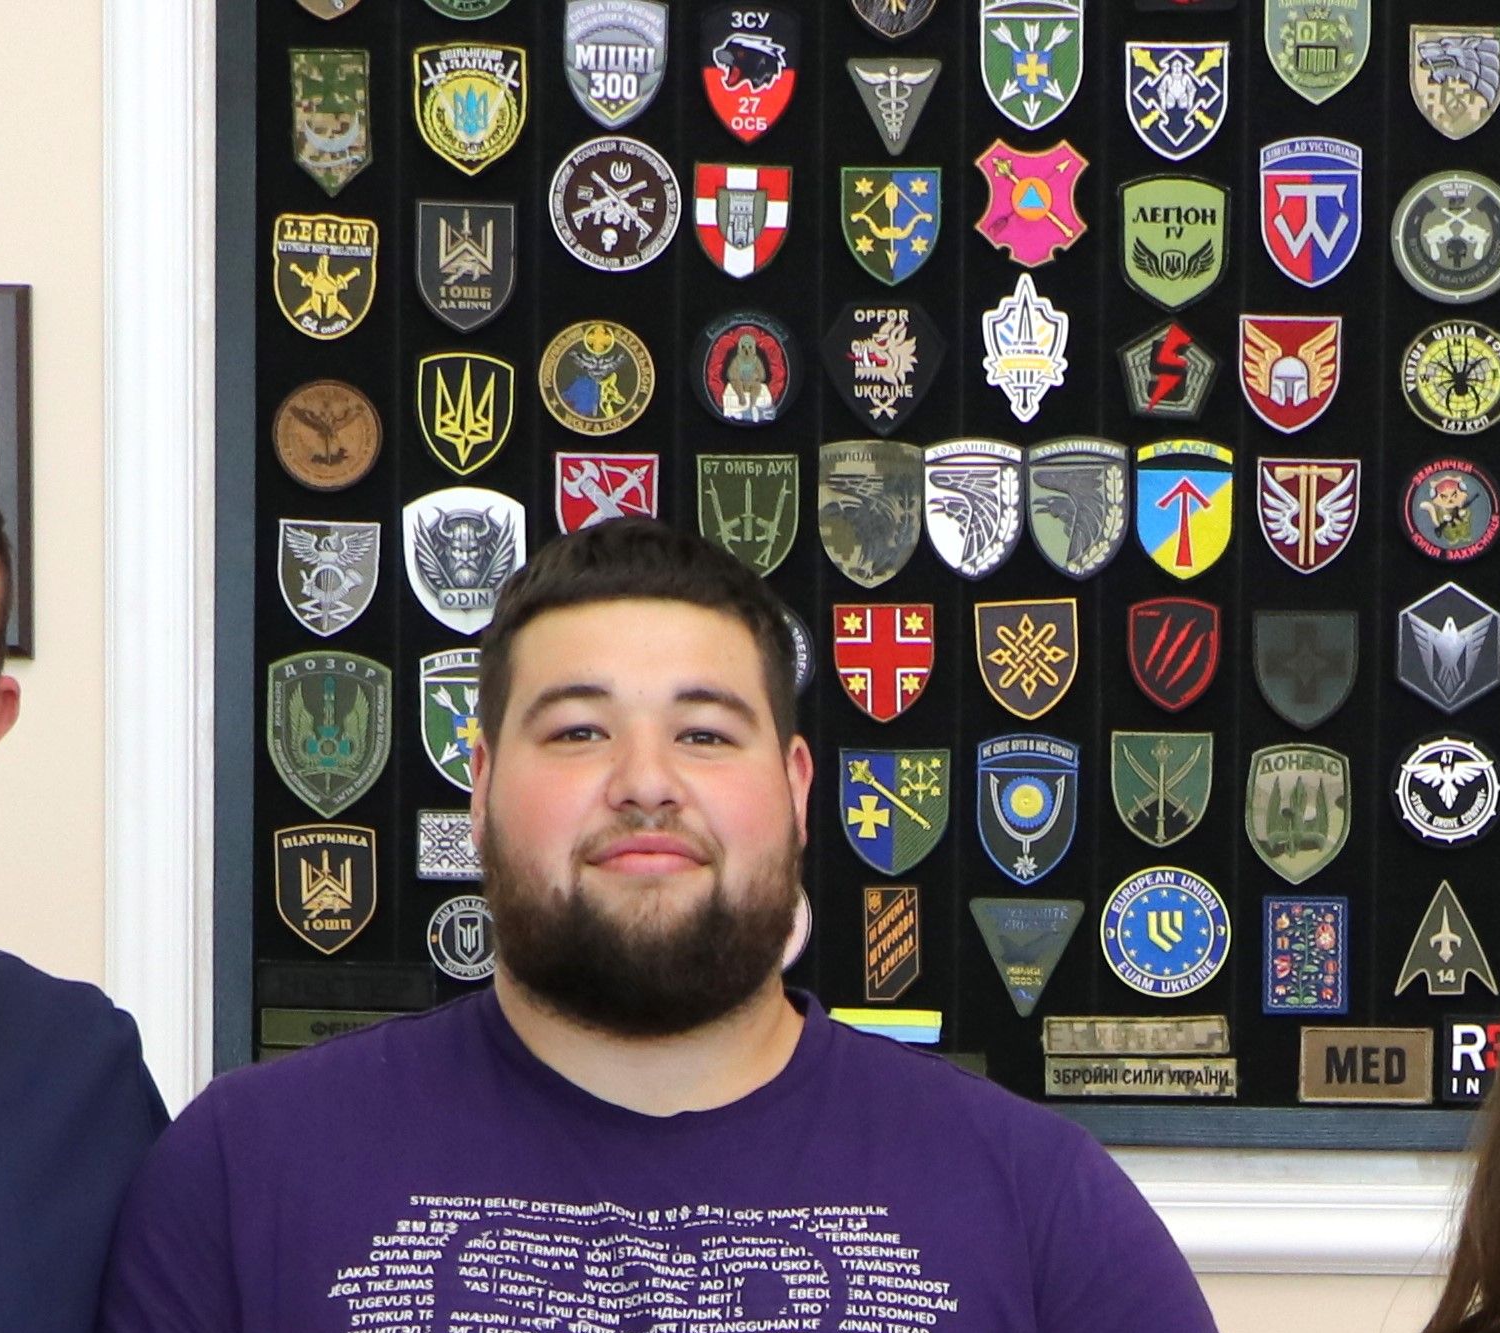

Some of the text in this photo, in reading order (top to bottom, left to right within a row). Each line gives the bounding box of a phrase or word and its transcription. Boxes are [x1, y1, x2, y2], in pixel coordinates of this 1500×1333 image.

[732, 12, 769, 29] ЗСУ
[575, 45, 656, 72] МІЦНІ
[590, 73, 637, 99] 300
[738, 97, 760, 114] 27
[732, 116, 767, 131] ОСБ
[1132, 207, 1216, 225] ЛЕГІОН
[284, 220, 369, 245] LEGION
[452, 287, 492, 299] ОШБ
[854, 309, 909, 323] OPFOR
[854, 384, 913, 398] UKRAINE
[702, 463, 719, 474] 67
[767, 461, 792, 476] ДУК
[444, 592, 490, 606] ODIN
[283, 659, 377, 679] ДОЗОР
[1260, 756, 1340, 776] ДОНБАС
[1111, 872, 1219, 914] EUROPEAN UNION
[1117, 959, 1217, 992] EUAM UKRAINE
[1437, 970, 1456, 983] 14
[1325, 1045, 1405, 1084] MED
[1052, 1066, 1229, 1086] ЗБРОЙНІ СИЛИ УКРАЇНИ
[410, 1195, 636, 1220] STRENGTH BELIEF DETERMINATION
[429, 1210, 480, 1220] STYRKA
[734, 1210, 764, 1221] GÜÇ
[369, 1249, 442, 1262] СИЛА ВІРА
[617, 1245, 668, 1264] STÄRKE
[336, 1264, 434, 1280] LAKAS TIWALA
[771, 1260, 810, 1272] USKO
[499, 1284, 543, 1298] KRAFT
[868, 1276, 950, 1295] PREDANOST
[347, 1296, 412, 1310] TUGEVUS
[351, 1310, 414, 1326] STYRKUR
[689, 1318, 800, 1333] KETANGGUHAN
